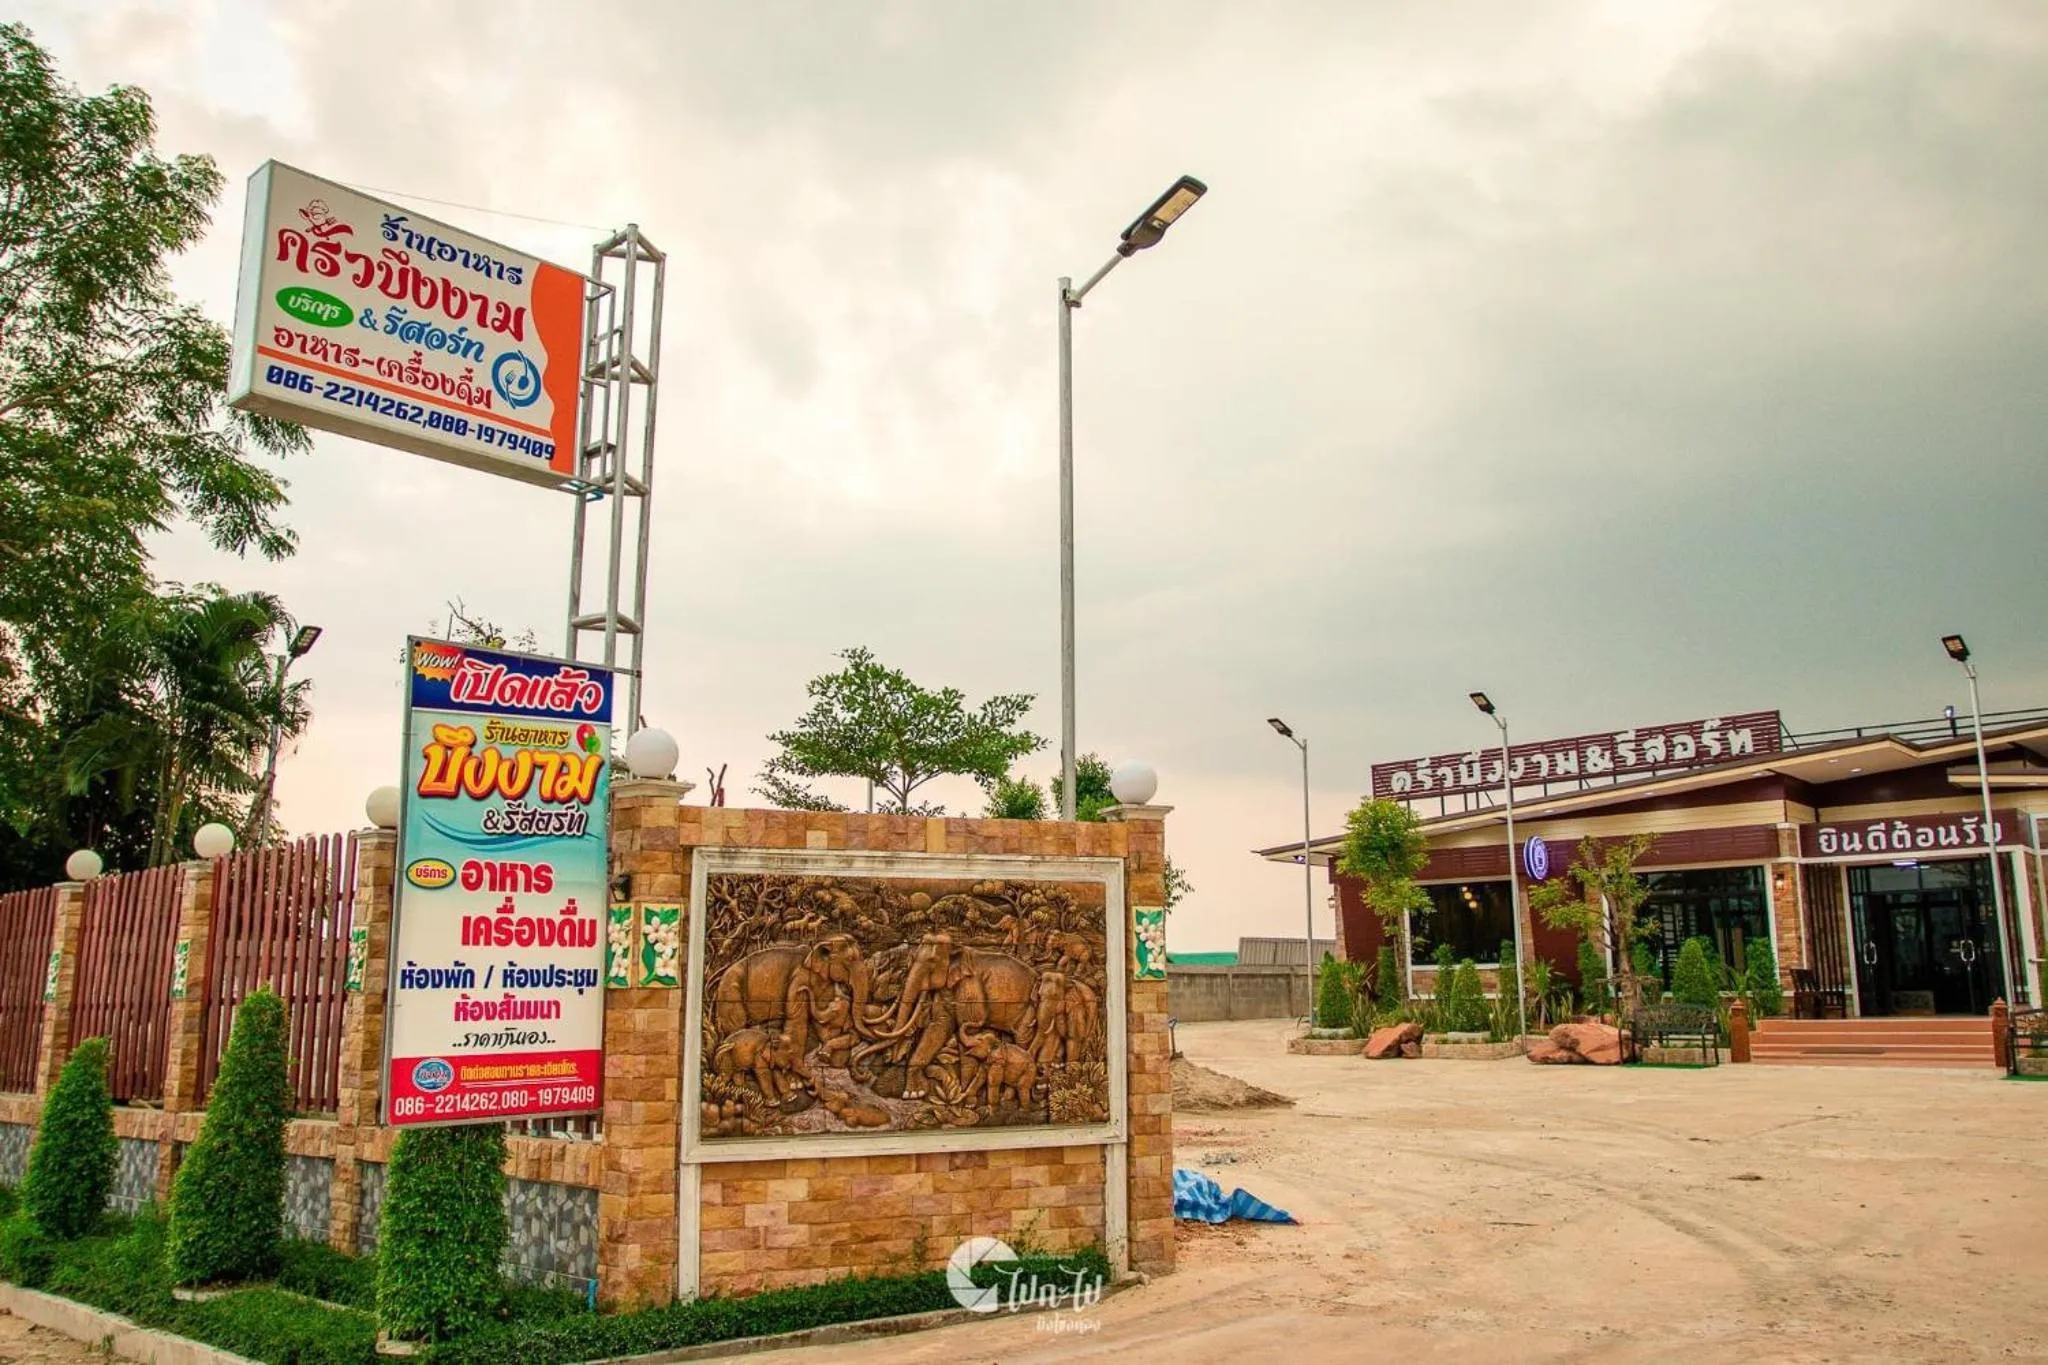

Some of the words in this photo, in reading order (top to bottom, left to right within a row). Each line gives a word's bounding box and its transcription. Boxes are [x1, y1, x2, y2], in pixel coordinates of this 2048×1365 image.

[380, 213, 524, 285] ร้านอาหาร
[276, 223, 526, 342] ครัวบึงงาม
[287, 293, 342, 320] บริการ
[266, 364, 556, 461] 086-2214262,080-1979409
[451, 659, 603, 713] เปิดแล้ว
[484, 720, 569, 747] ร้านอาหาร
[417, 723, 605, 805] บึงงาม
[1818, 816, 2002, 853] ยินดีต้อนรับ
[415, 865, 448, 879] บริการ
[461, 860, 555, 894] อาหาร
[461, 896, 597, 948] เครื่องดื่ม
[400, 960, 475, 990] ห้องพัก
[502, 961, 598, 996] ห้องประชุม
[454, 993, 561, 1022] ห้องสัมมนา
